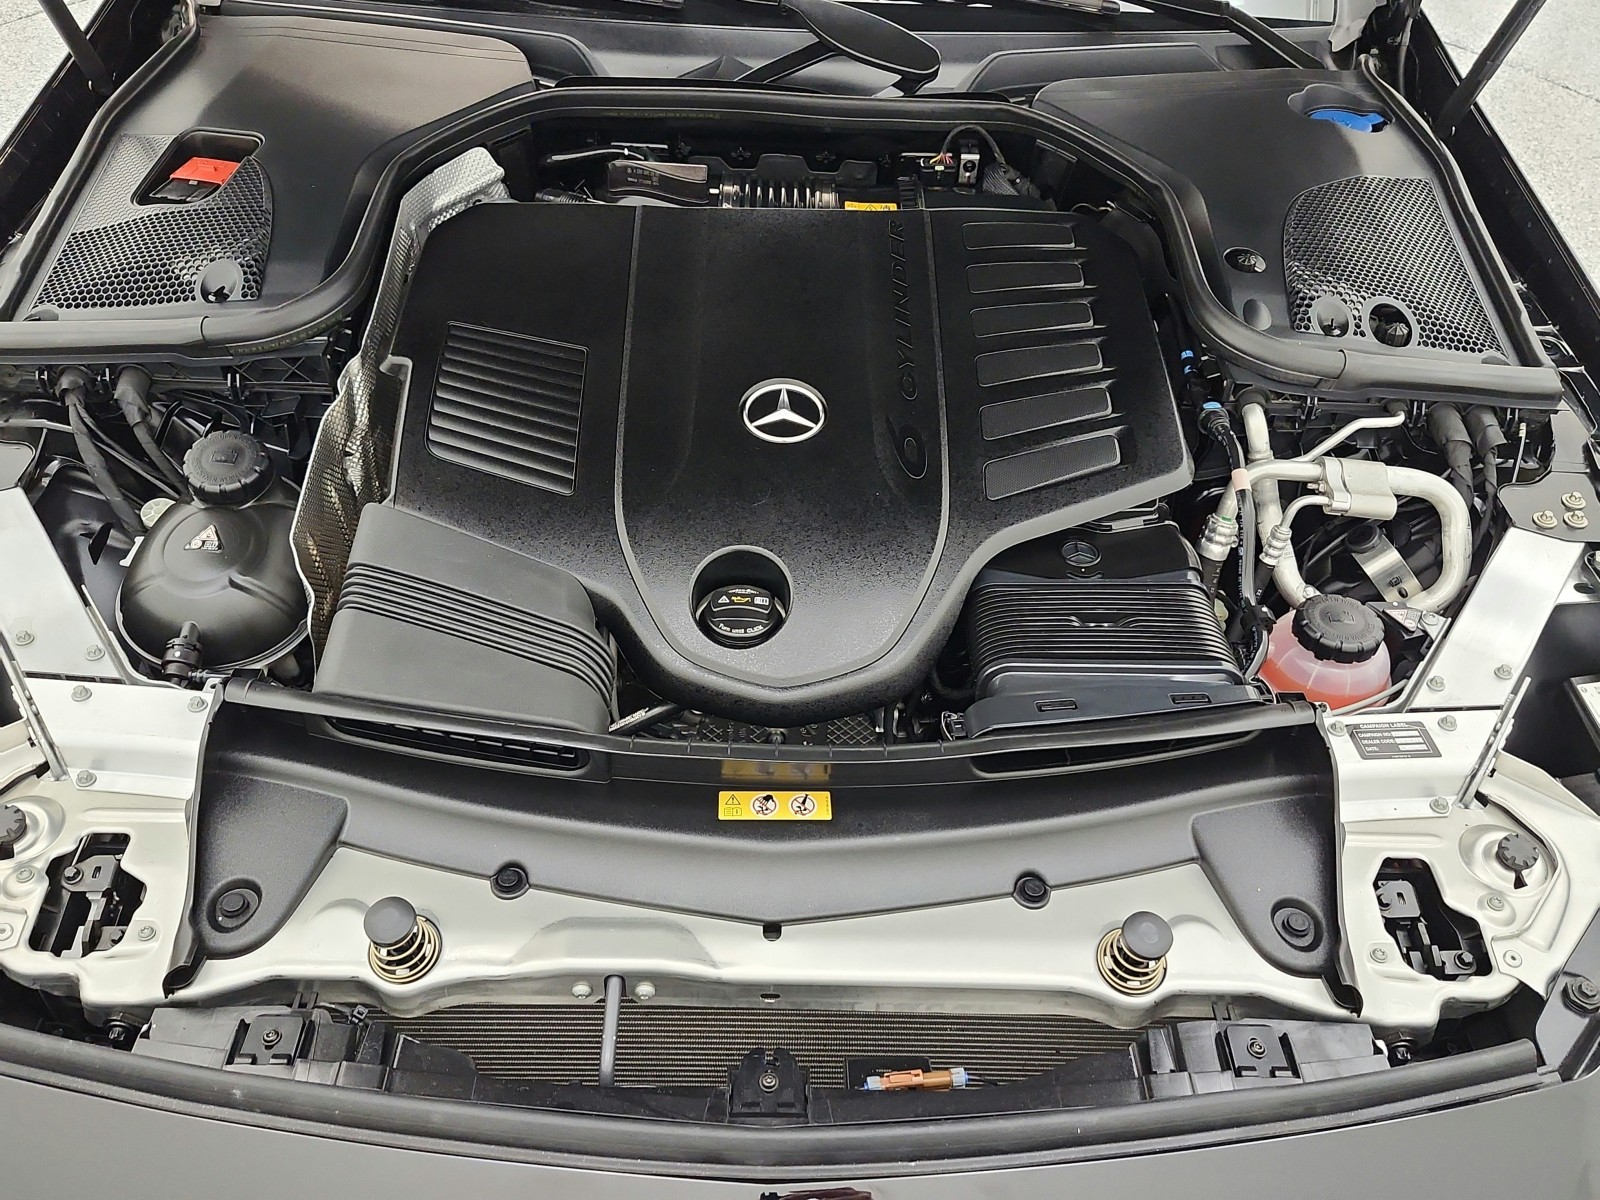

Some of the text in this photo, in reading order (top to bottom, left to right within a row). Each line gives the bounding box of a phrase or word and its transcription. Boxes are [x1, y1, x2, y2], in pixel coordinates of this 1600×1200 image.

[888, 218, 918, 401] CYLINDER
[718, 622, 731, 632] Turn
[746, 624, 764, 633] CLICK
